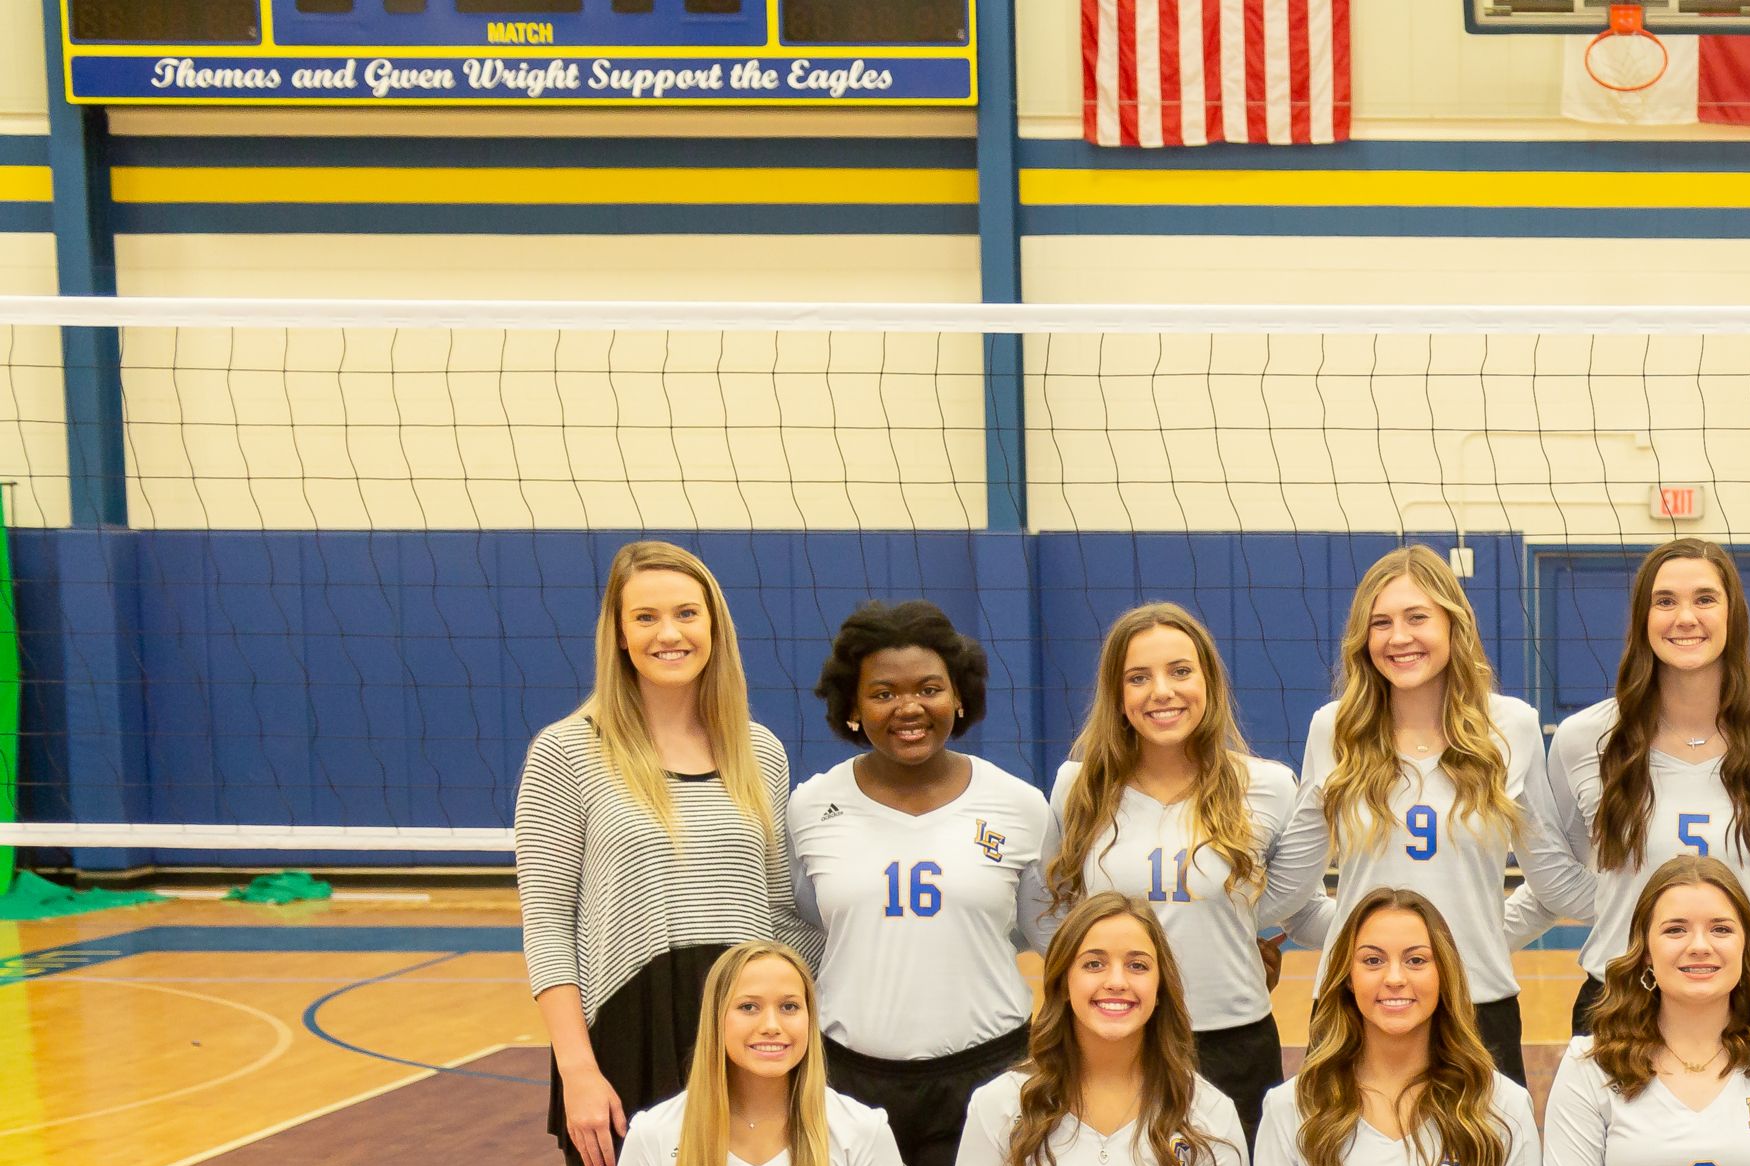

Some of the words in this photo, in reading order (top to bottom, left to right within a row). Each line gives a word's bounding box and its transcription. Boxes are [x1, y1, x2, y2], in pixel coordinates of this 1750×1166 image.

[487, 22, 553, 44] MATCH
[151, 58, 281, 89] Thomas
[291, 58, 358, 89] and
[364, 58, 455, 98] Gwen
[462, 58, 581, 98] Wright
[588, 58, 723, 98] Support
[730, 59, 780, 90] the
[786, 58, 893, 98] Eagles
[1661, 488, 1694, 515] EXIT
[1405, 804, 1438, 862] 9
[1678, 812, 1711, 857] 5
[883, 860, 943, 919] 16
[1146, 846, 1192, 903] 11
